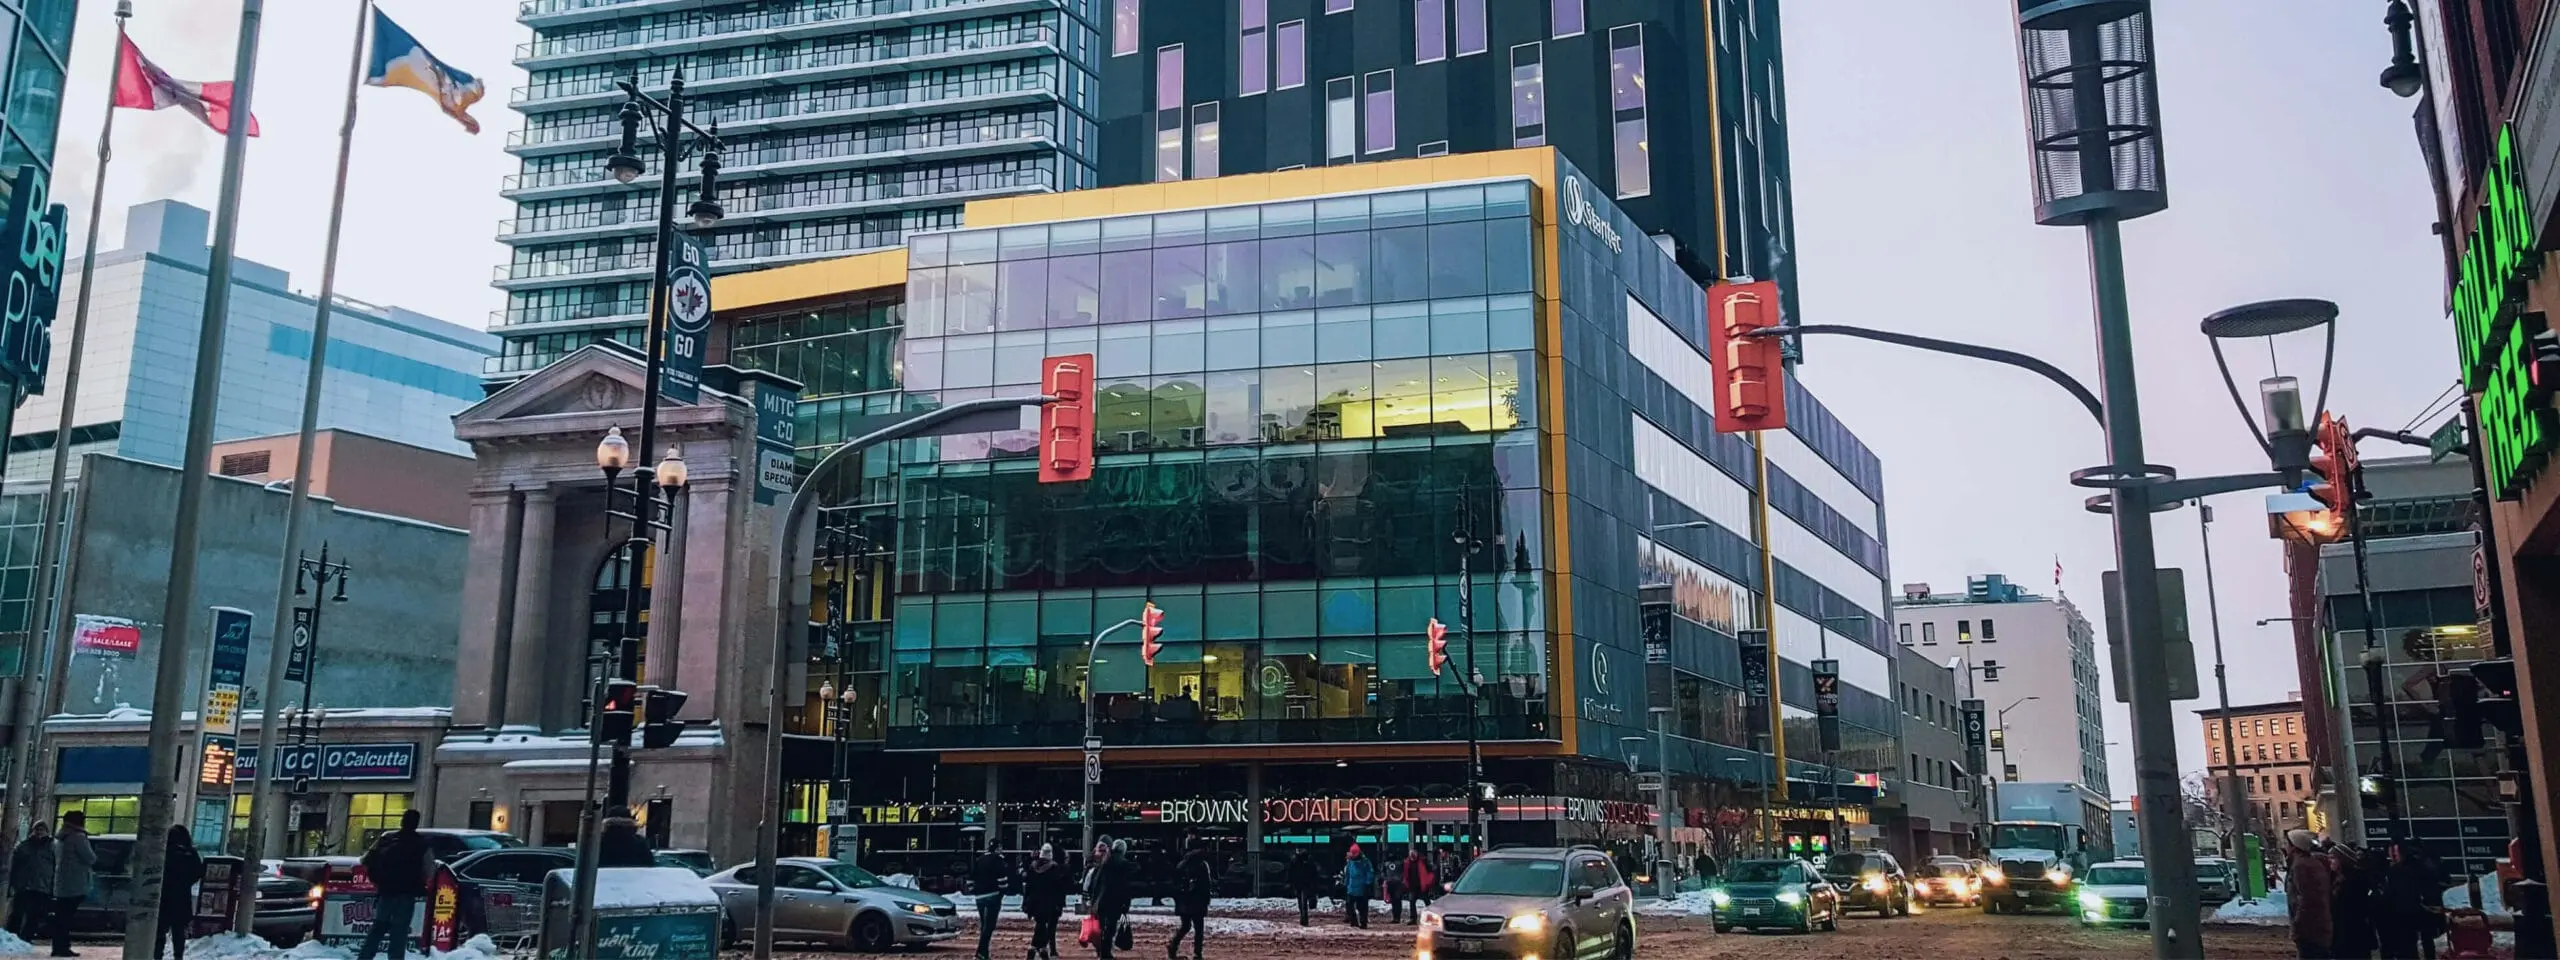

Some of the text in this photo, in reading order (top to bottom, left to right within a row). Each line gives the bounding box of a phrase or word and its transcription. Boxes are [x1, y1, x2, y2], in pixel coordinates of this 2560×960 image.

[1582, 200, 1622, 255] Stantec
[682, 241, 700, 267] GO
[2453, 122, 2530, 392] DOLLAR
[674, 333, 695, 358] GO
[764, 392, 794, 417] MITC
[2480, 316, 2540, 501] TREE
[770, 458, 792, 473] DIAM
[764, 471, 793, 487] SPECIA
[328, 751, 408, 767] O Calcutta
[1161, 799, 1249, 822] BROWNS
[1568, 798, 1603, 822] BROWNS
